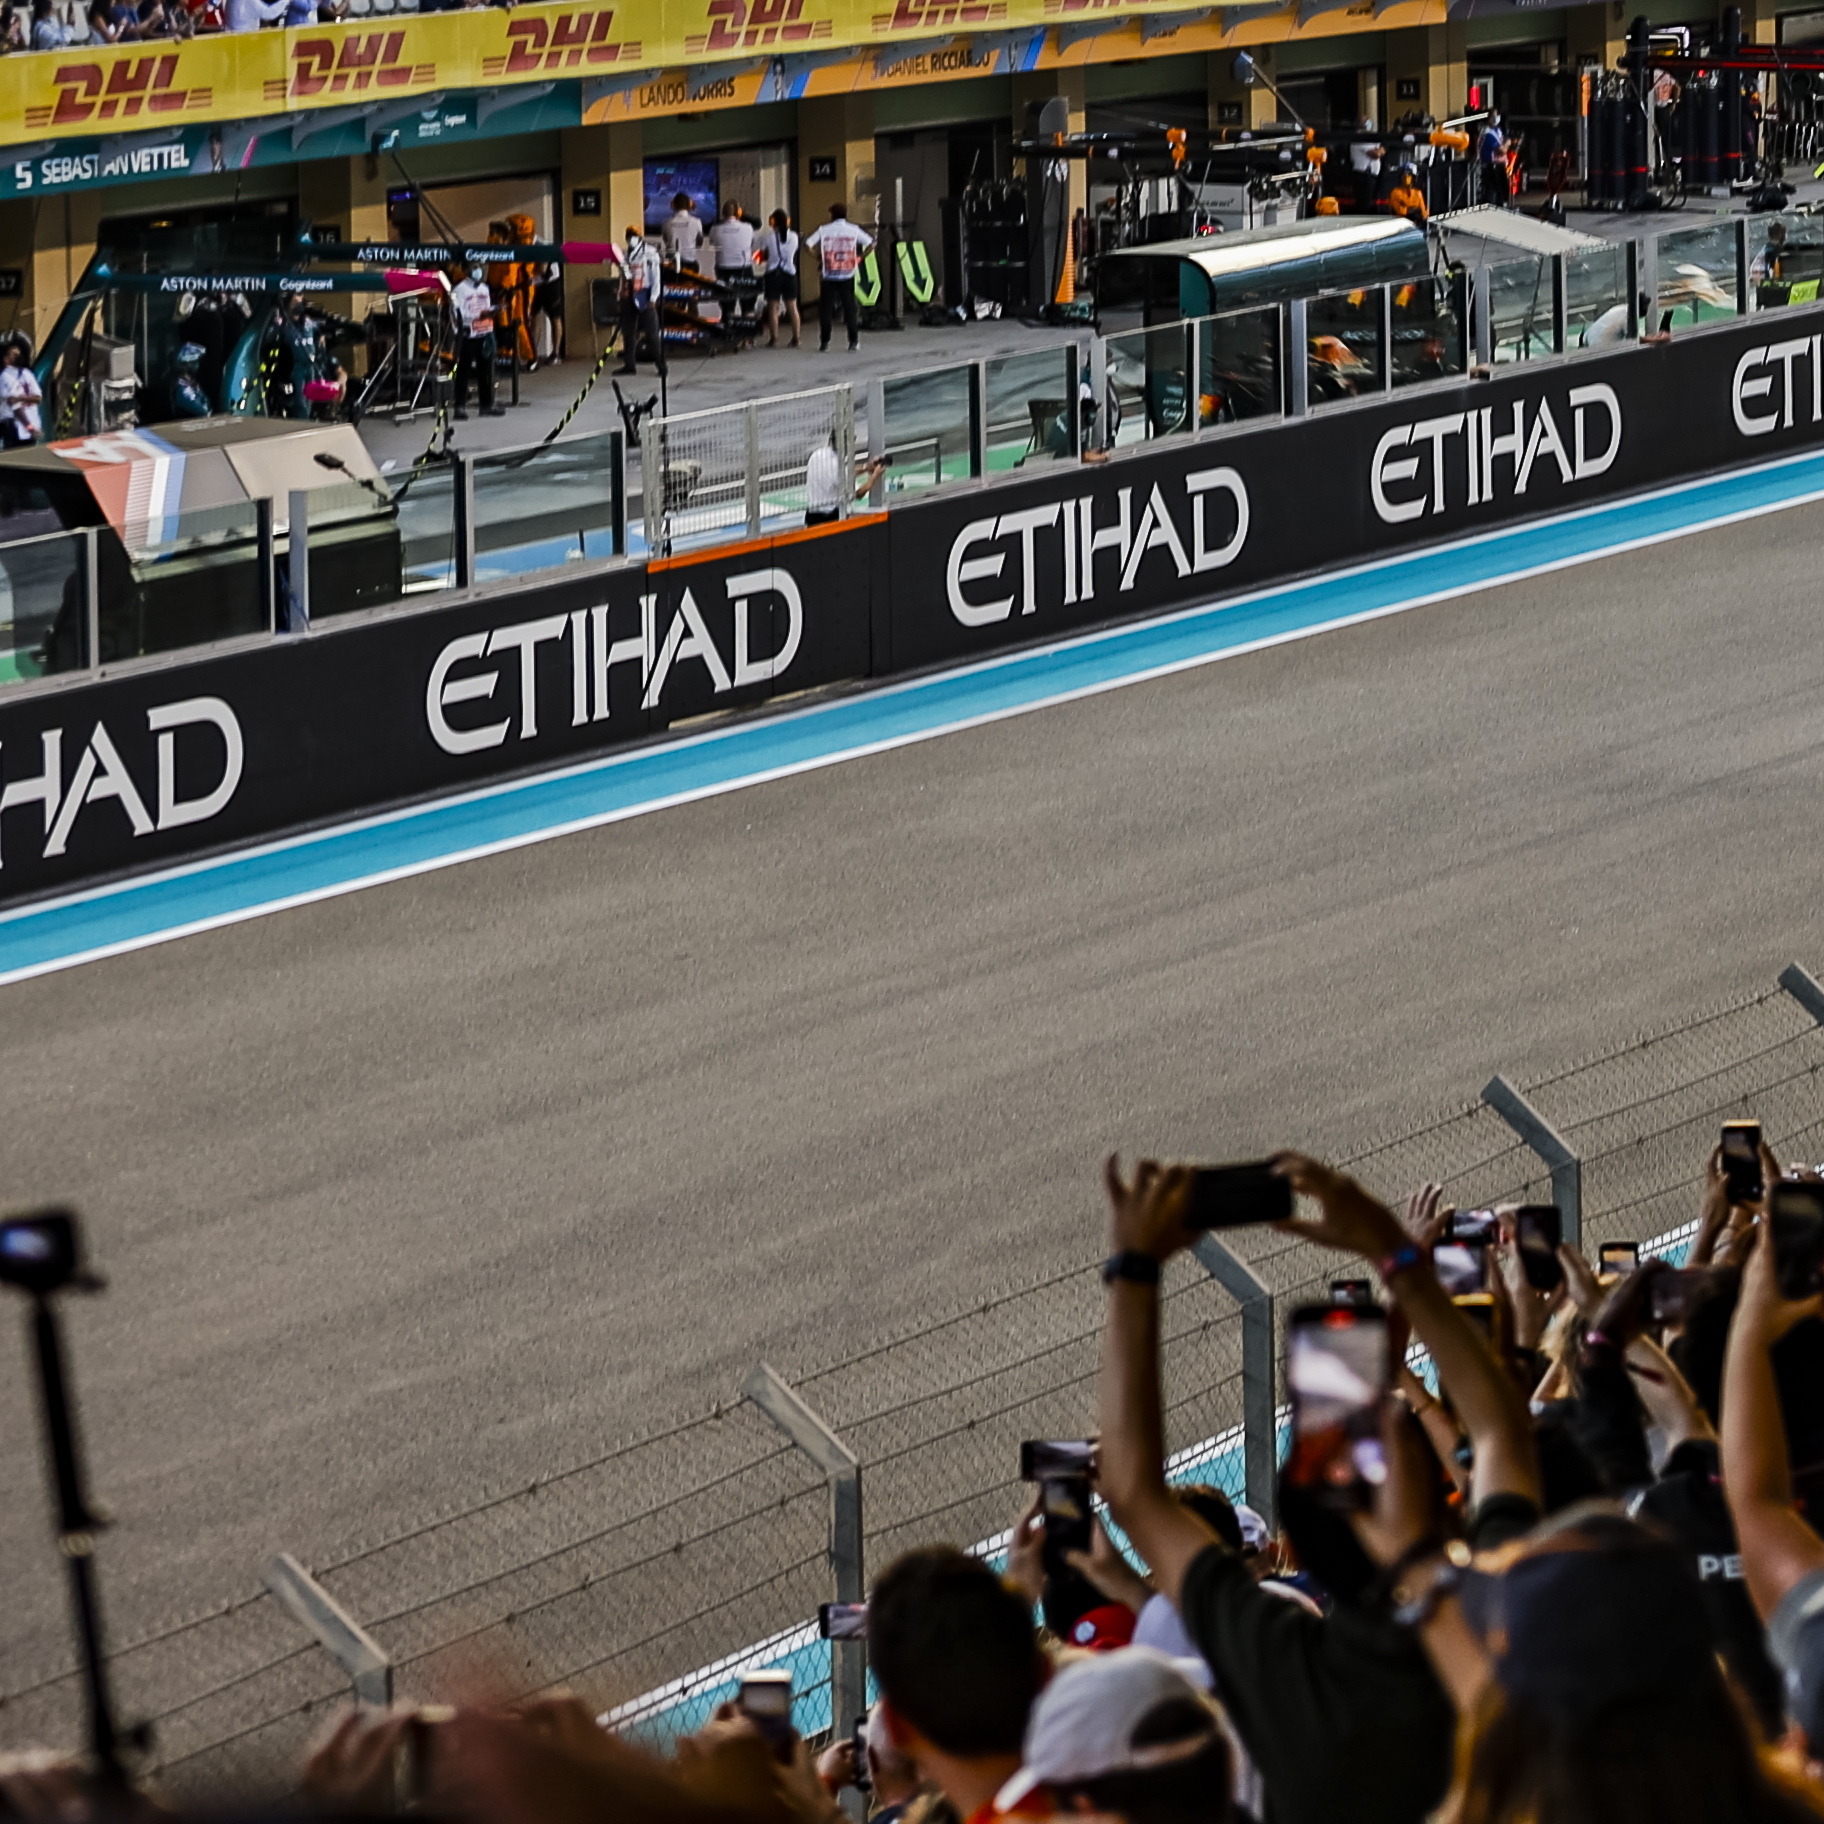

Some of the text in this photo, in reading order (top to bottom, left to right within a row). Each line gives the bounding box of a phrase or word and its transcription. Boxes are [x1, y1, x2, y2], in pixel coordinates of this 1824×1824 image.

[289, 30, 413, 98] DHL
[504, 10, 622, 74] DHL
[51, 54, 188, 125] DHL
[640, 81, 685, 108] LANDO
[15, 142, 190, 190] 5 SEBASTAN VETTEL
[813, 162, 831, 176] 14
[578, 196, 596, 209] 15
[160, 277, 208, 292] ASTON
[211, 277, 266, 292] MARTIN
[357, 248, 399, 262] ASTON
[404, 248, 451, 262] MARTIN
[1370, 382, 1623, 525] ETIHAD
[945, 466, 1250, 628] ETIHAD
[427, 567, 803, 755] ETIHAD
[0, 695, 244, 869] HAD
